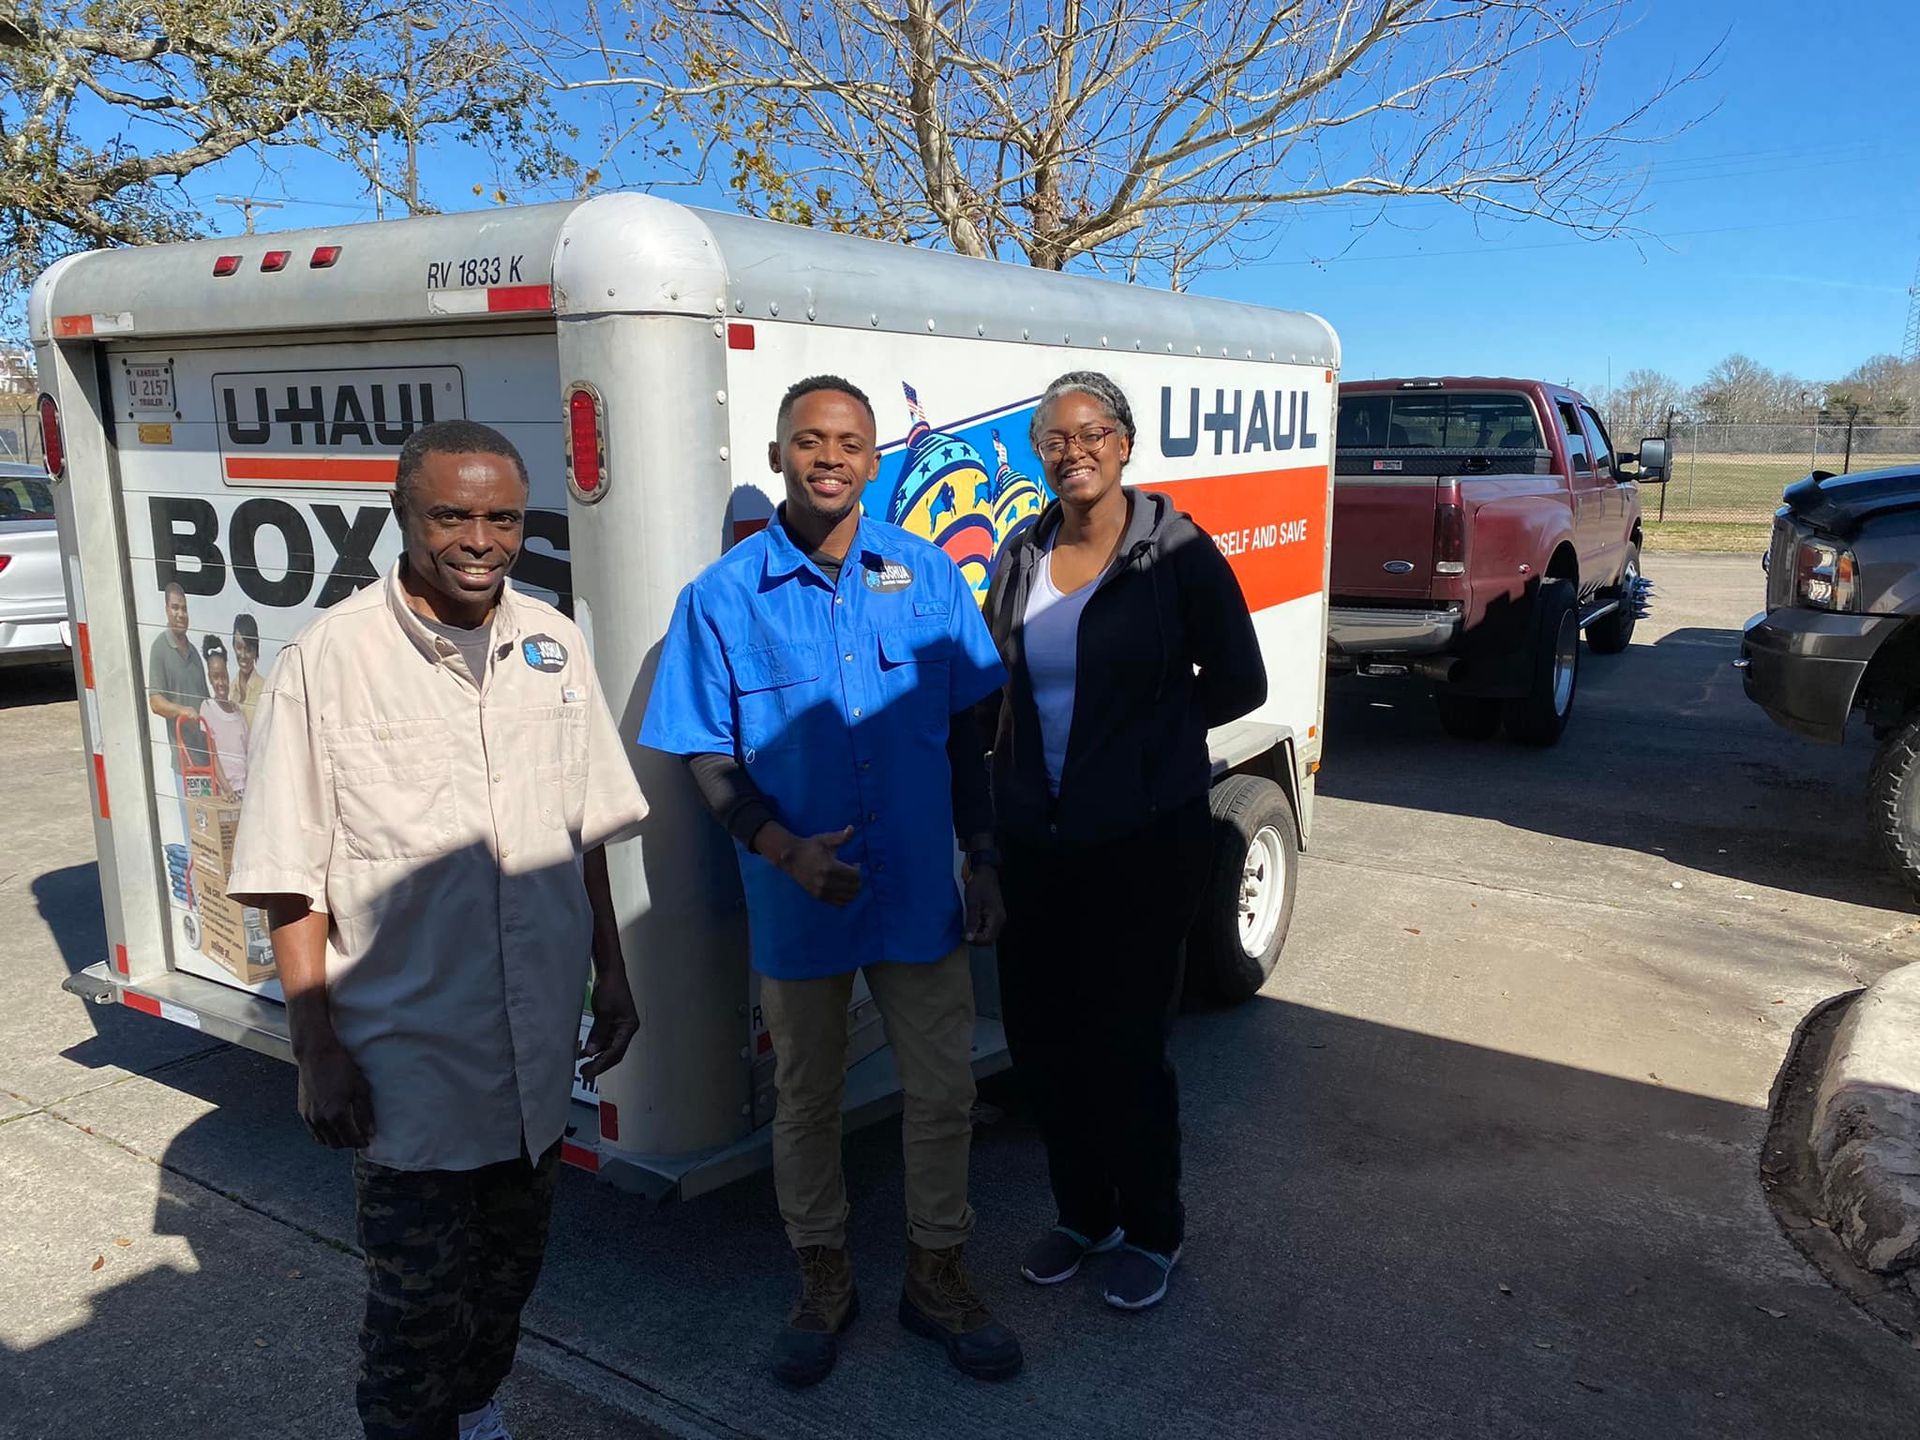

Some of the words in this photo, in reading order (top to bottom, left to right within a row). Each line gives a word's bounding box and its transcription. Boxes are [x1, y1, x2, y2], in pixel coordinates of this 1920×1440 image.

[428, 261, 452, 289] RV
[459, 257, 501, 287] 1833
[509, 254, 524, 283] K
[129, 380, 137, 396] U
[143, 380, 169, 396] 2157
[1160, 386, 1317, 458] U-HAUL
[1211, 528, 1250, 557] RSELF
[1251, 525, 1277, 551] AND
[1279, 519, 1308, 545] SAVE
[148, 496, 576, 623] BOXS
[752, 1004, 764, 1031] R
